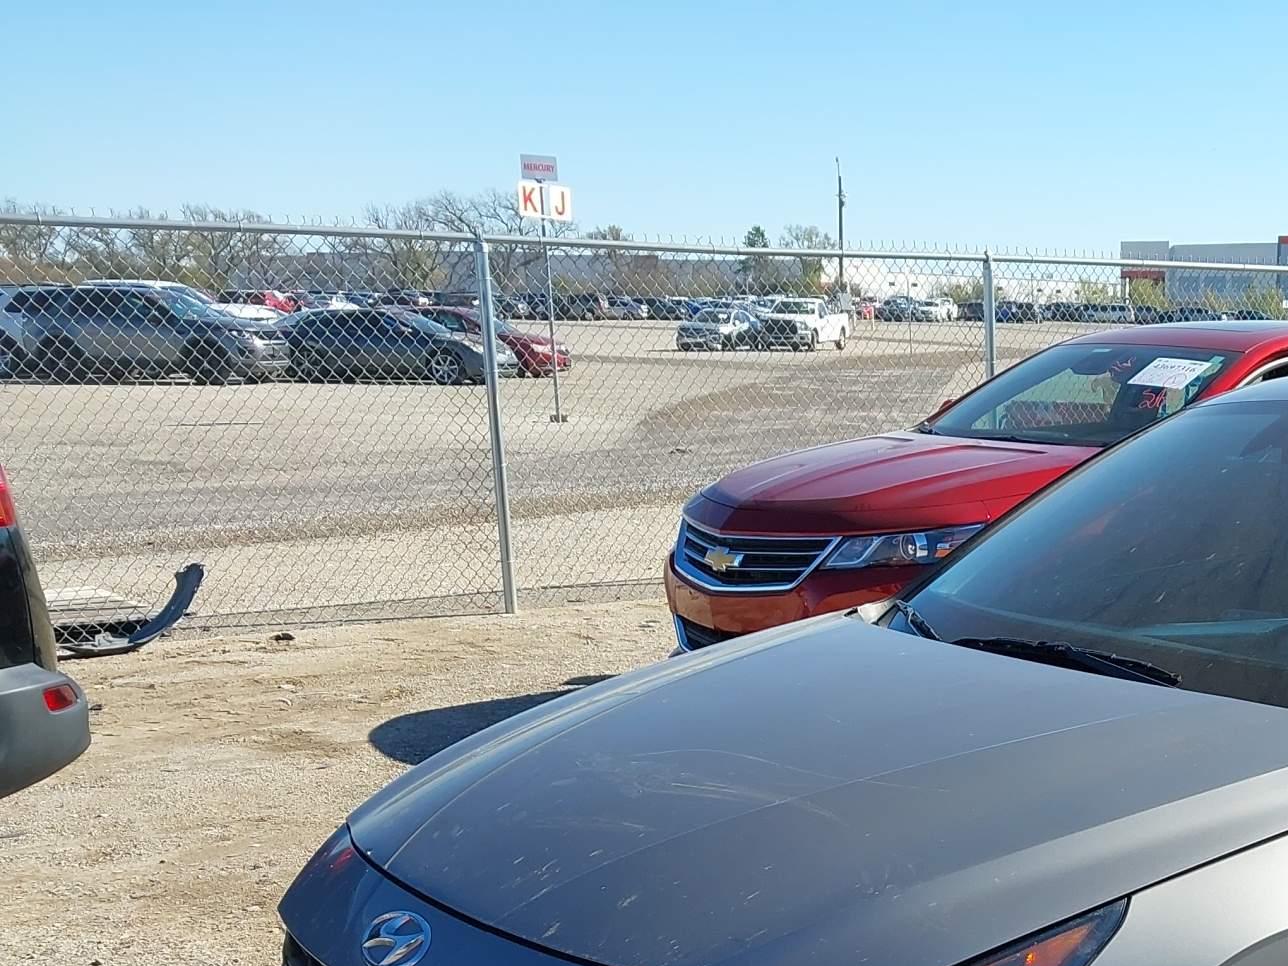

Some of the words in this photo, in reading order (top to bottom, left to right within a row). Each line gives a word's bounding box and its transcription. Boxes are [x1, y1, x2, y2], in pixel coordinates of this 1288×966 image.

[523, 162, 555, 173] MERCURY
[522, 185, 538, 213] K
[555, 191, 566, 215] J
